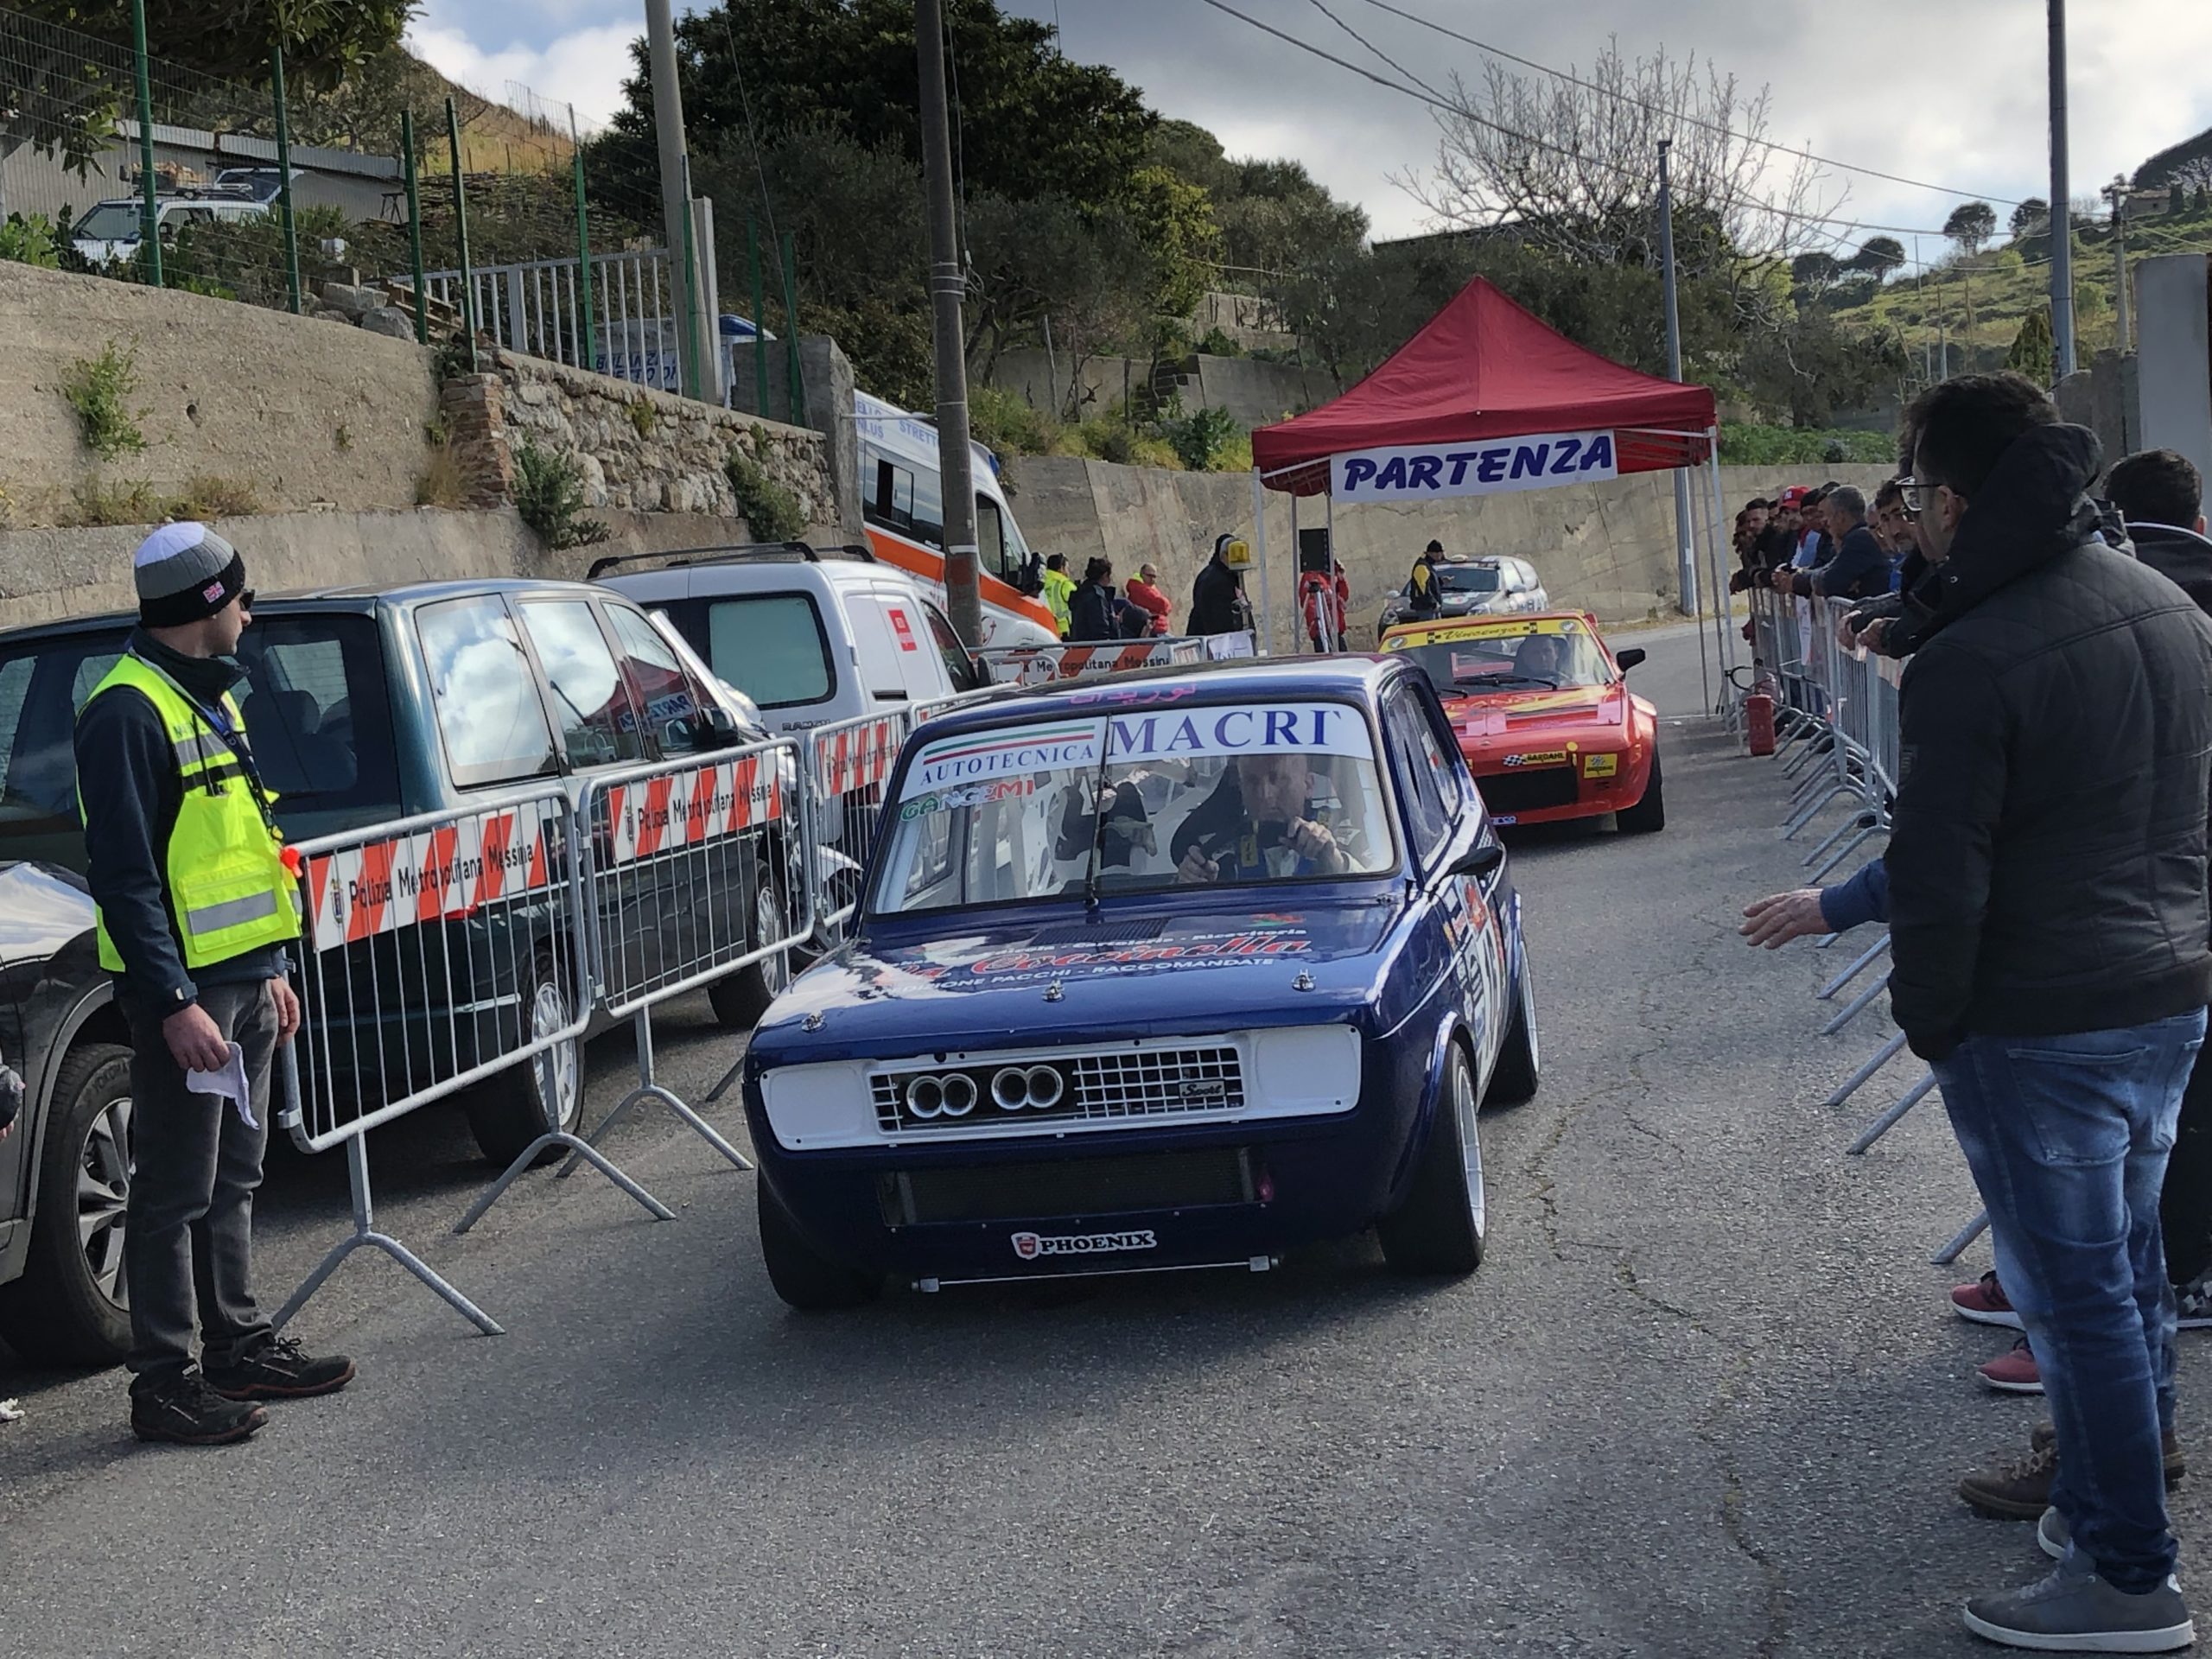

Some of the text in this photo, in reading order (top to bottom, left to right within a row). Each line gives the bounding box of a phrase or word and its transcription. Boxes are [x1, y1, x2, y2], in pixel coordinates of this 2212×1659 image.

[1344, 435, 1612, 491] PARTENZA
[1037, 658, 1118, 673] Meopolitana
[919, 744, 1094, 786] AUTOTECNICA
[901, 779, 1034, 821] GANGEMI
[349, 878, 391, 911] Polizia
[991, 969, 1071, 983] PACCHI
[1092, 958, 1274, 973] RACCOMANDATE
[1039, 1232, 1154, 1253] PHOENIX
